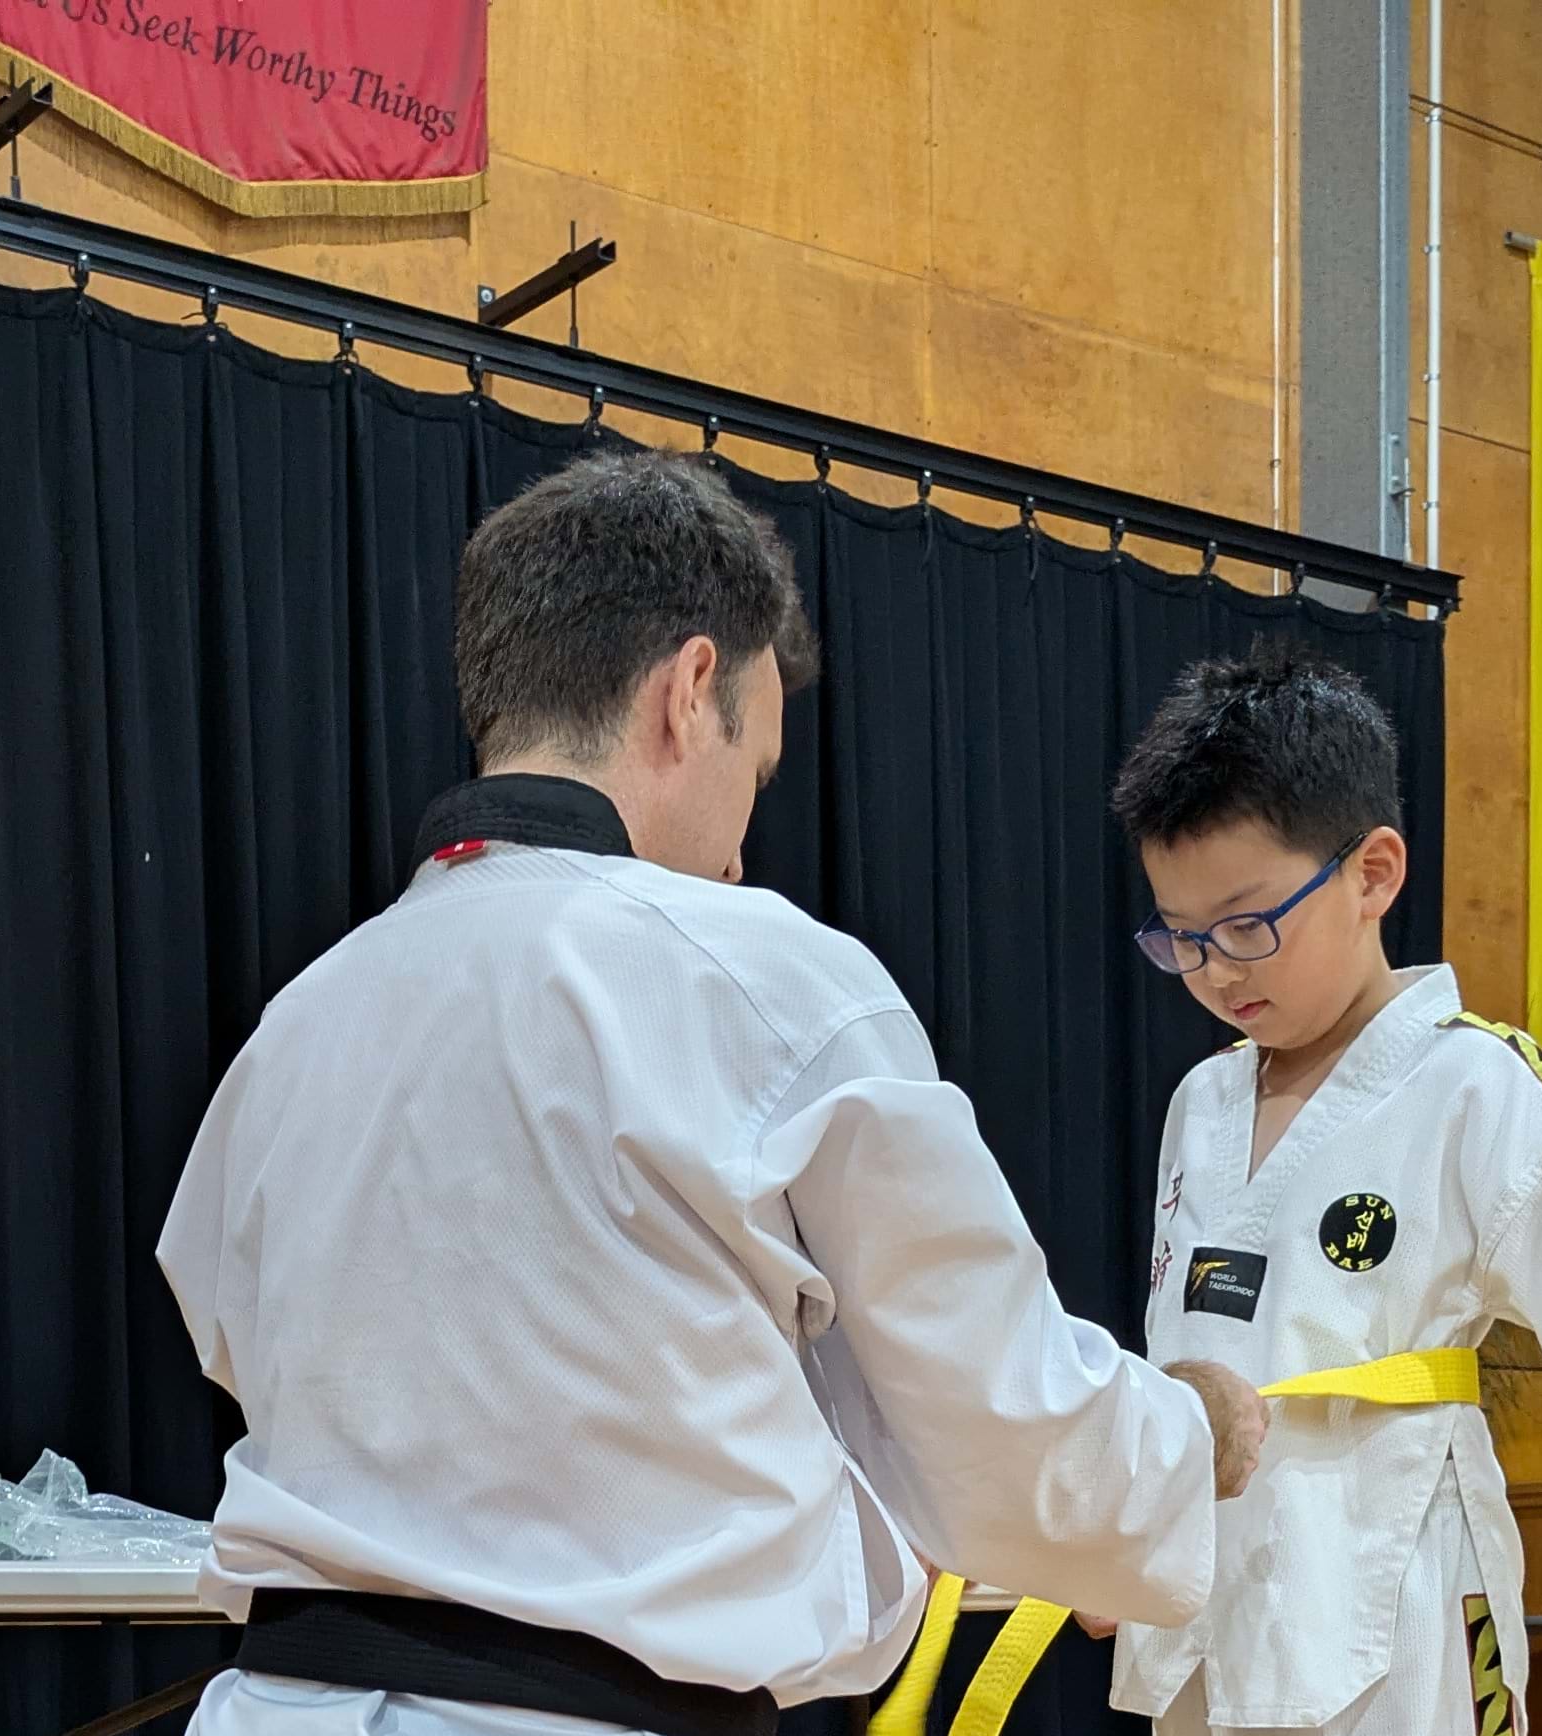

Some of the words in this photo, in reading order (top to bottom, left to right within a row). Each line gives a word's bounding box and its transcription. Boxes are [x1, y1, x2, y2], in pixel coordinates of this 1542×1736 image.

[120, 0, 203, 56] Seek
[212, 25, 337, 104] Worthy
[348, 66, 457, 143] Things
[1345, 1195, 1393, 1220] SUN
[1346, 1210, 1375, 1252] 선배
[1325, 1241, 1373, 1271] BAE
[1208, 1280, 1256, 1297] TAEKWONDO
[1209, 1271, 1237, 1283] WORLD
